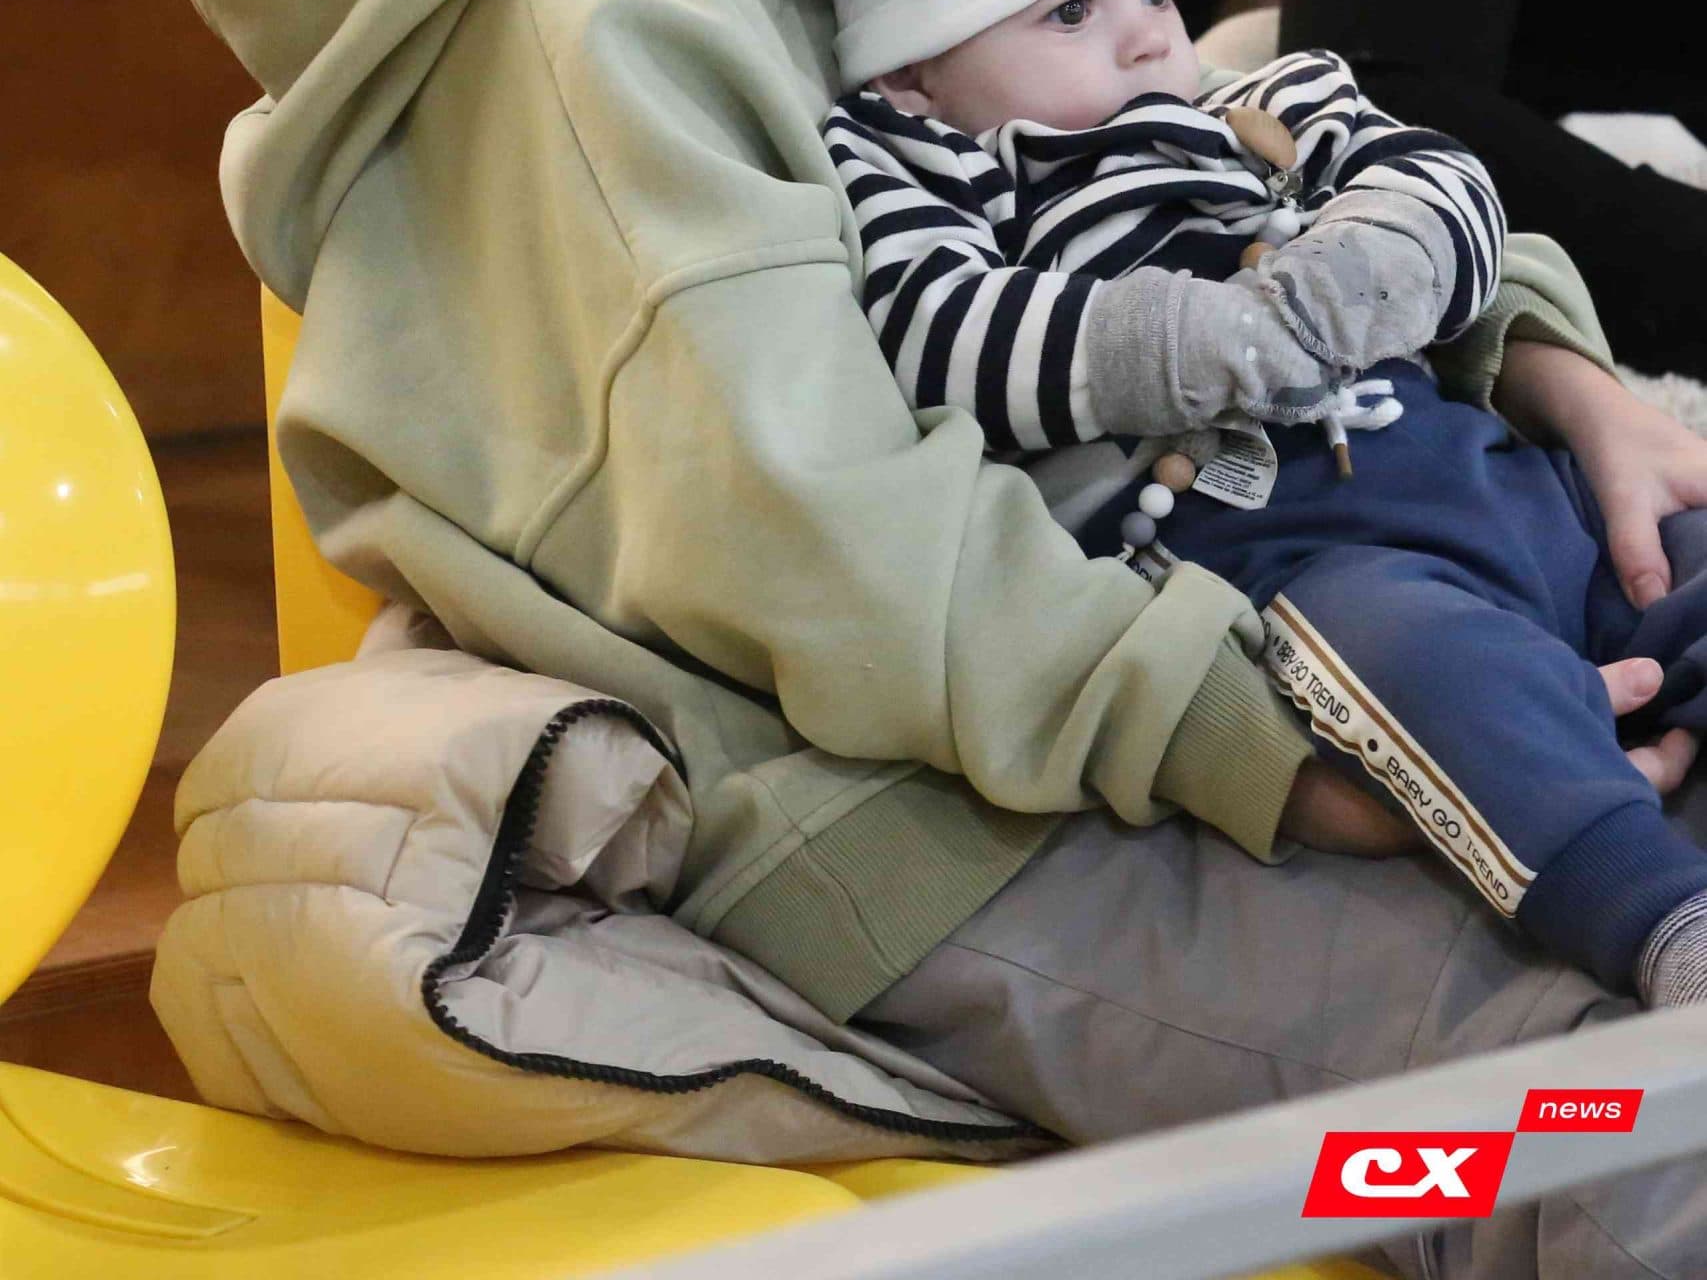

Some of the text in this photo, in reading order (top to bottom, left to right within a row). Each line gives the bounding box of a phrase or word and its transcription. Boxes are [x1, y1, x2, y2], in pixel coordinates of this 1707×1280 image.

[1291, 661, 1309, 681] GO
[1306, 673, 1350, 725] TREND
[1386, 756, 1509, 901] BABY GO TREND
